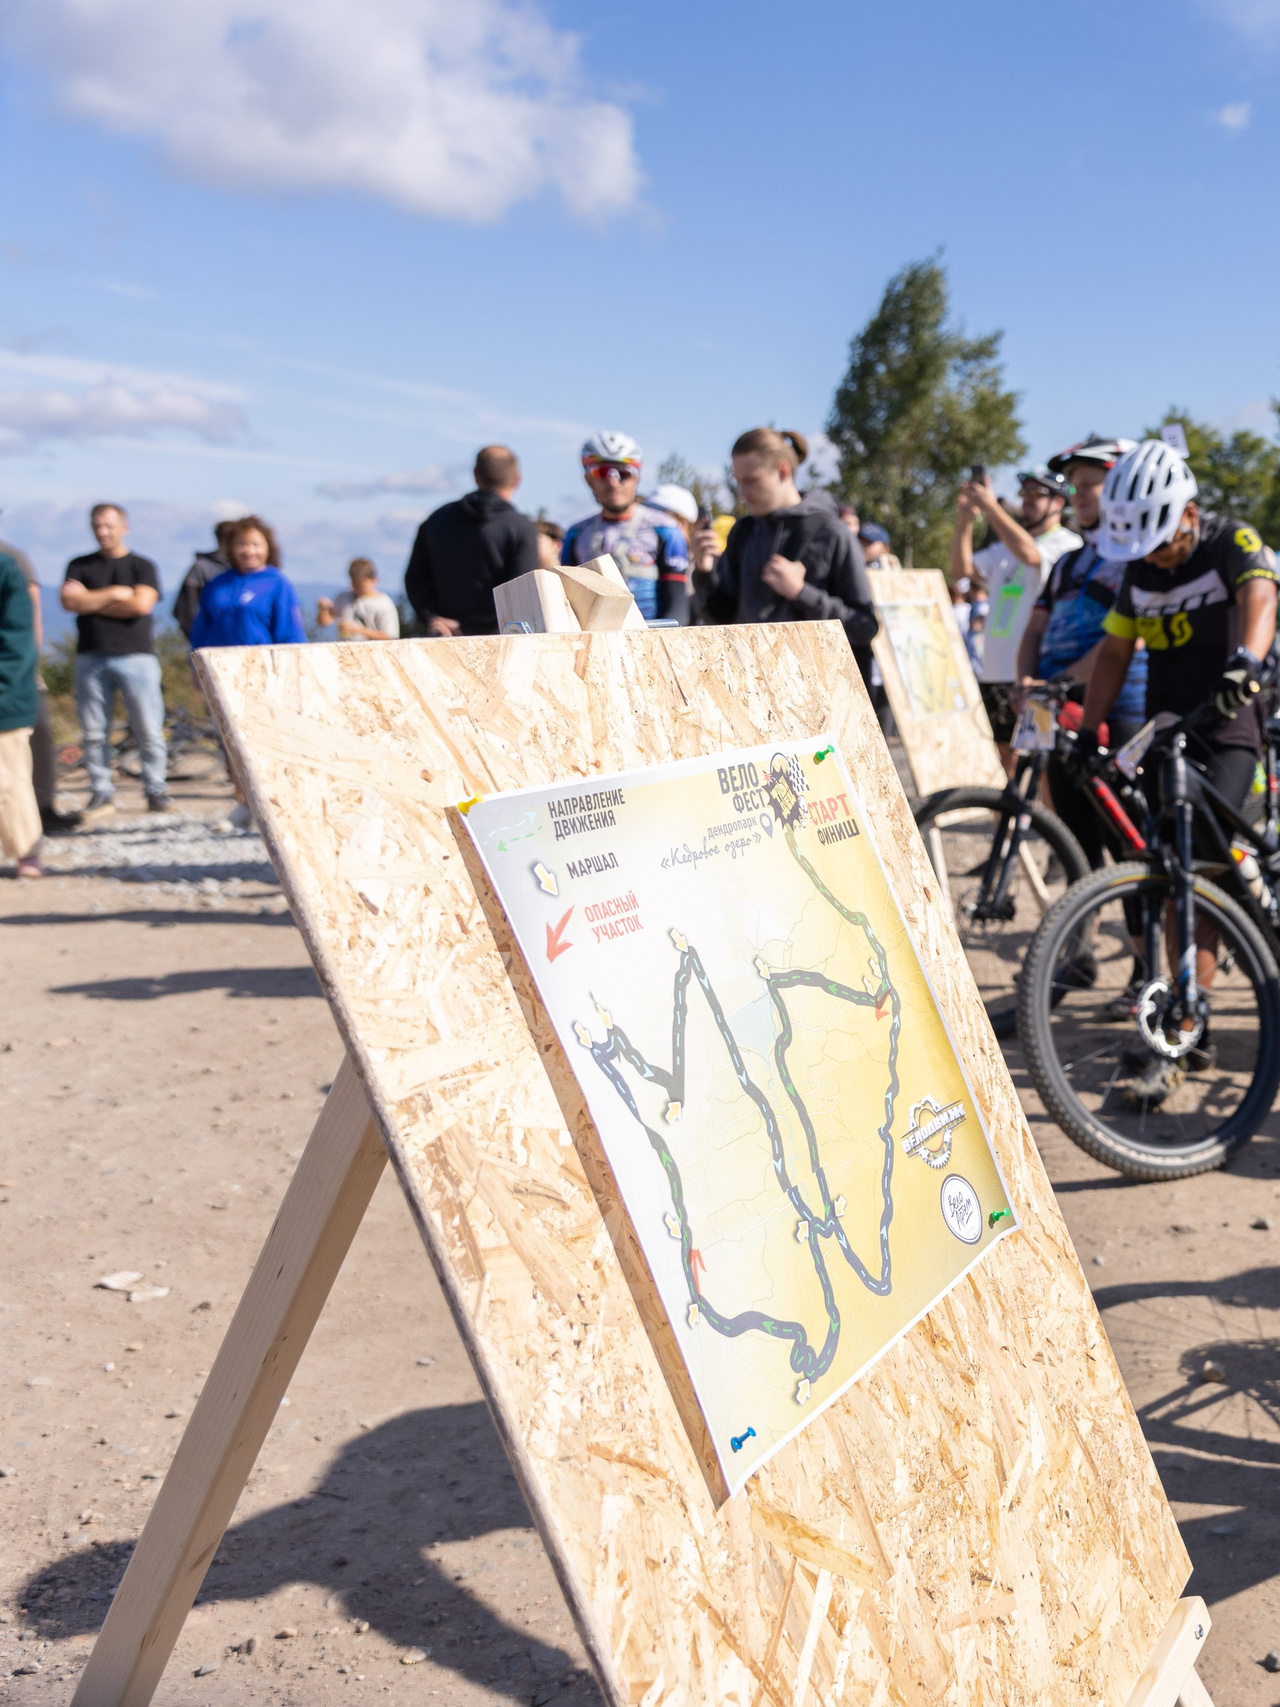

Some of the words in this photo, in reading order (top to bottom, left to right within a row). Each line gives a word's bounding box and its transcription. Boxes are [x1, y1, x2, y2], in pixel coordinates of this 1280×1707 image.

[716, 761, 760, 795] ВЕЛО
[547, 788, 626, 819] НАПРАВЛЕНИЕ
[732, 788, 768, 814] ФЕСТ
[806, 793, 852, 826] СТАРТ
[553, 809, 617, 842] ДВИЖЕНИЯ
[706, 815, 758, 841] дендропарк
[816, 818, 860, 847] ФИНИШ
[565, 851, 620, 880] МАРШАЛ
[584, 890, 640, 923] ОПАСНЫЙ
[591, 913, 644, 944] УЧАСТОК
[900, 1103, 967, 1154] ВЕЛОДВИЖ
